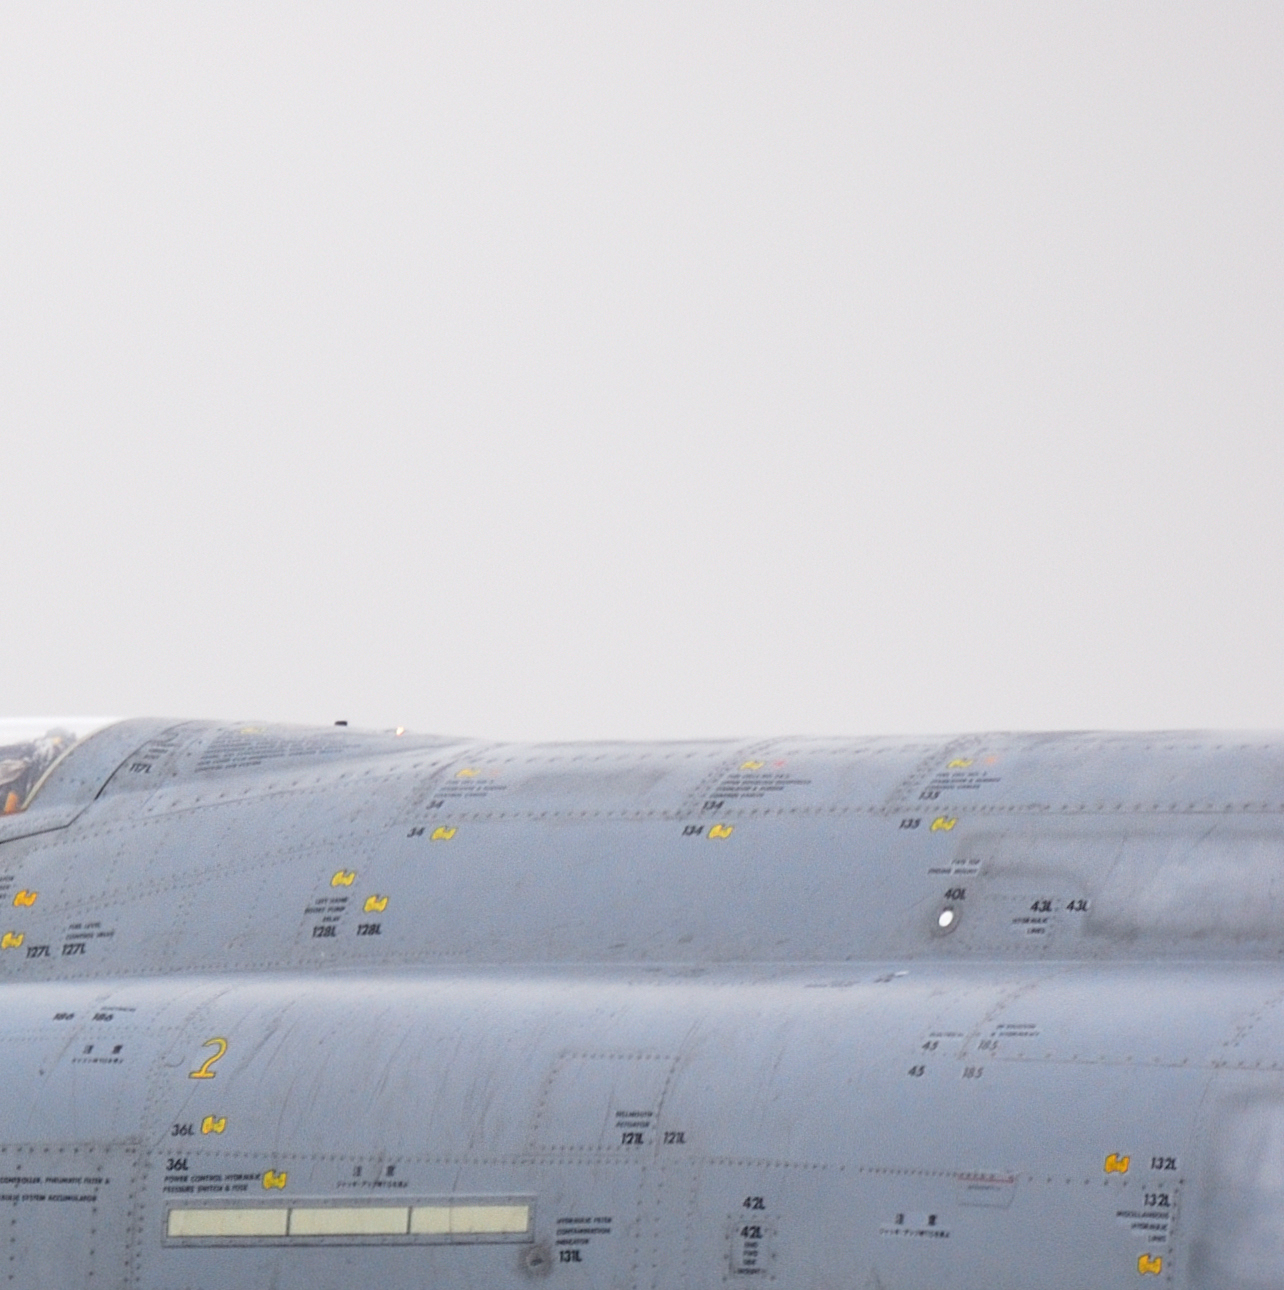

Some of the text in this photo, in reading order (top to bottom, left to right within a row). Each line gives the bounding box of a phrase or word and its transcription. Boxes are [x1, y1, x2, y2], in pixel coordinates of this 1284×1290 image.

[681, 825, 705, 836] 134
[898, 818, 922, 829] 135
[944, 887, 967, 900] 40L
[1029, 900, 1053, 913] 43L
[1065, 899, 1089, 912] 43L
[311, 925, 336, 938] 128L
[356, 923, 382, 936] 128L
[25, 945, 51, 959] 127L
[61, 942, 86, 956] 127L
[188, 1036, 228, 1079] 2
[907, 1064, 926, 1077] 45
[961, 1066, 984, 1080] 185
[170, 1123, 195, 1137] 36L
[621, 1131, 644, 1145] 121L
[662, 1131, 686, 1145] 121L
[165, 1158, 190, 1172] 36L
[1150, 1156, 1177, 1171] 132L
[742, 1196, 766, 1210] 42L
[1144, 1192, 1171, 1208] 132L
[740, 1225, 764, 1240] 42L
[559, 1249, 583, 1263] 131L
